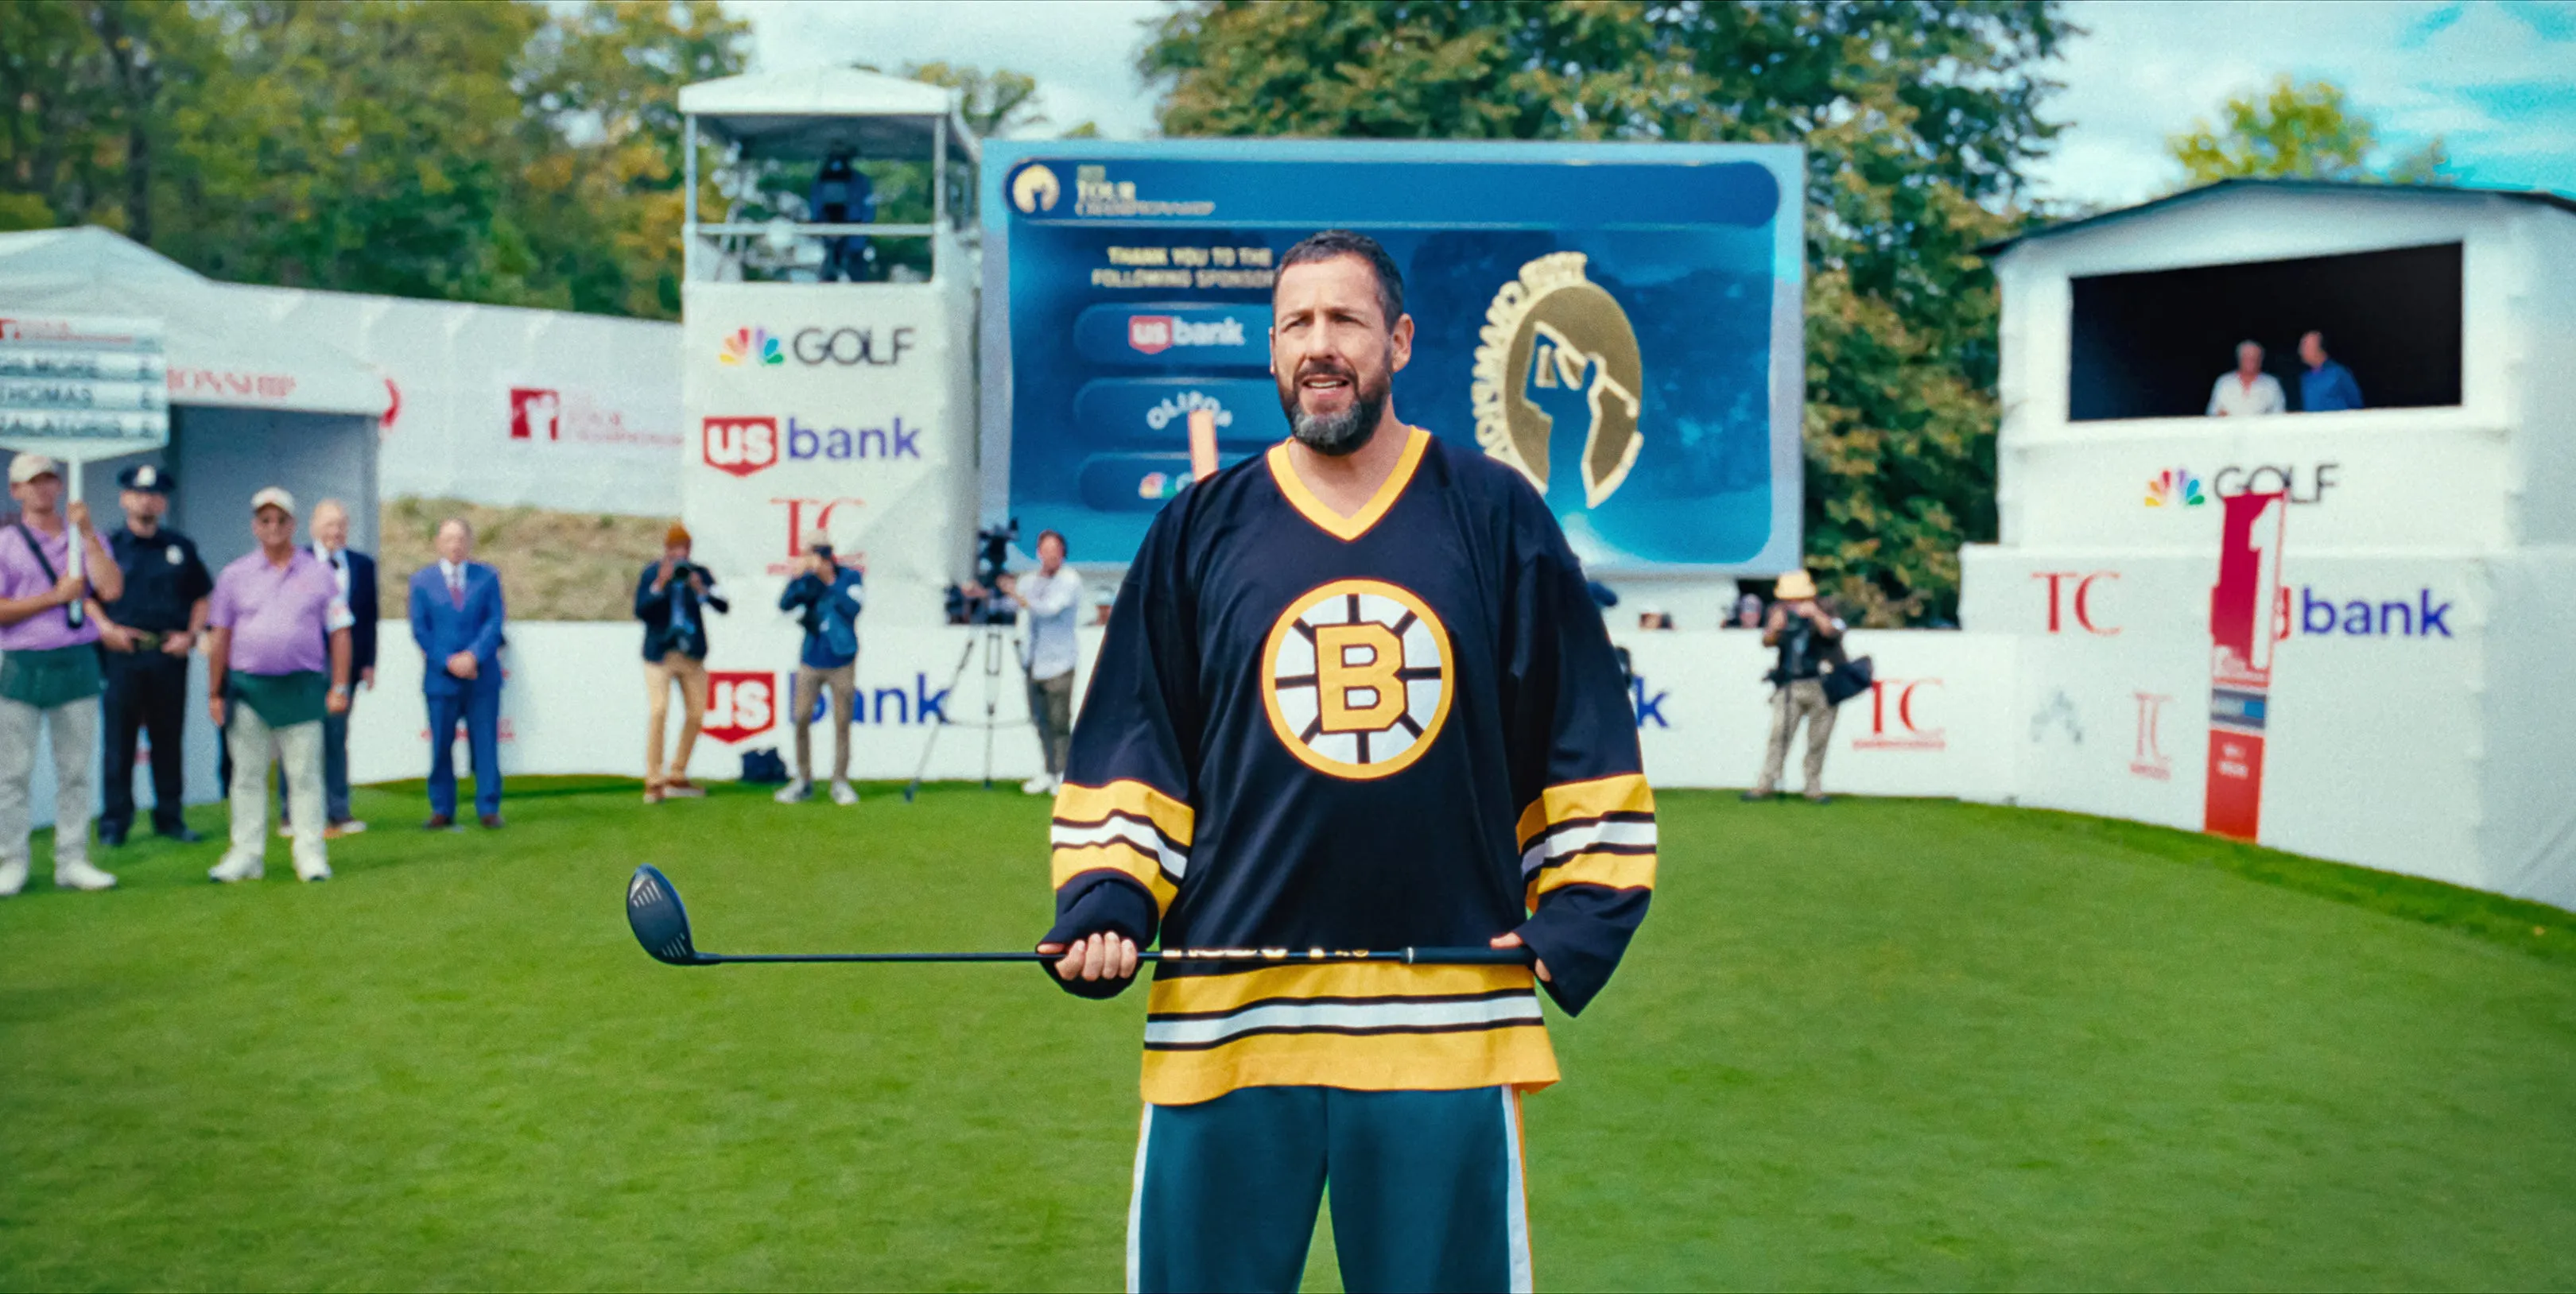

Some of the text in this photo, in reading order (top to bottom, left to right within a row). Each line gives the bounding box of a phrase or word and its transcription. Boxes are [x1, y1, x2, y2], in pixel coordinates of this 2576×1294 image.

[792, 326, 916, 366] GOLF
[1173, 316, 1246, 346] bank
[788, 416, 921, 459] bank
[2214, 463, 2340, 506] GOLF
[2031, 571, 2122, 635] TC
[2247, 502, 2283, 670] 1
[2302, 587, 2455, 638] bank
[1312, 619, 1410, 736] B
